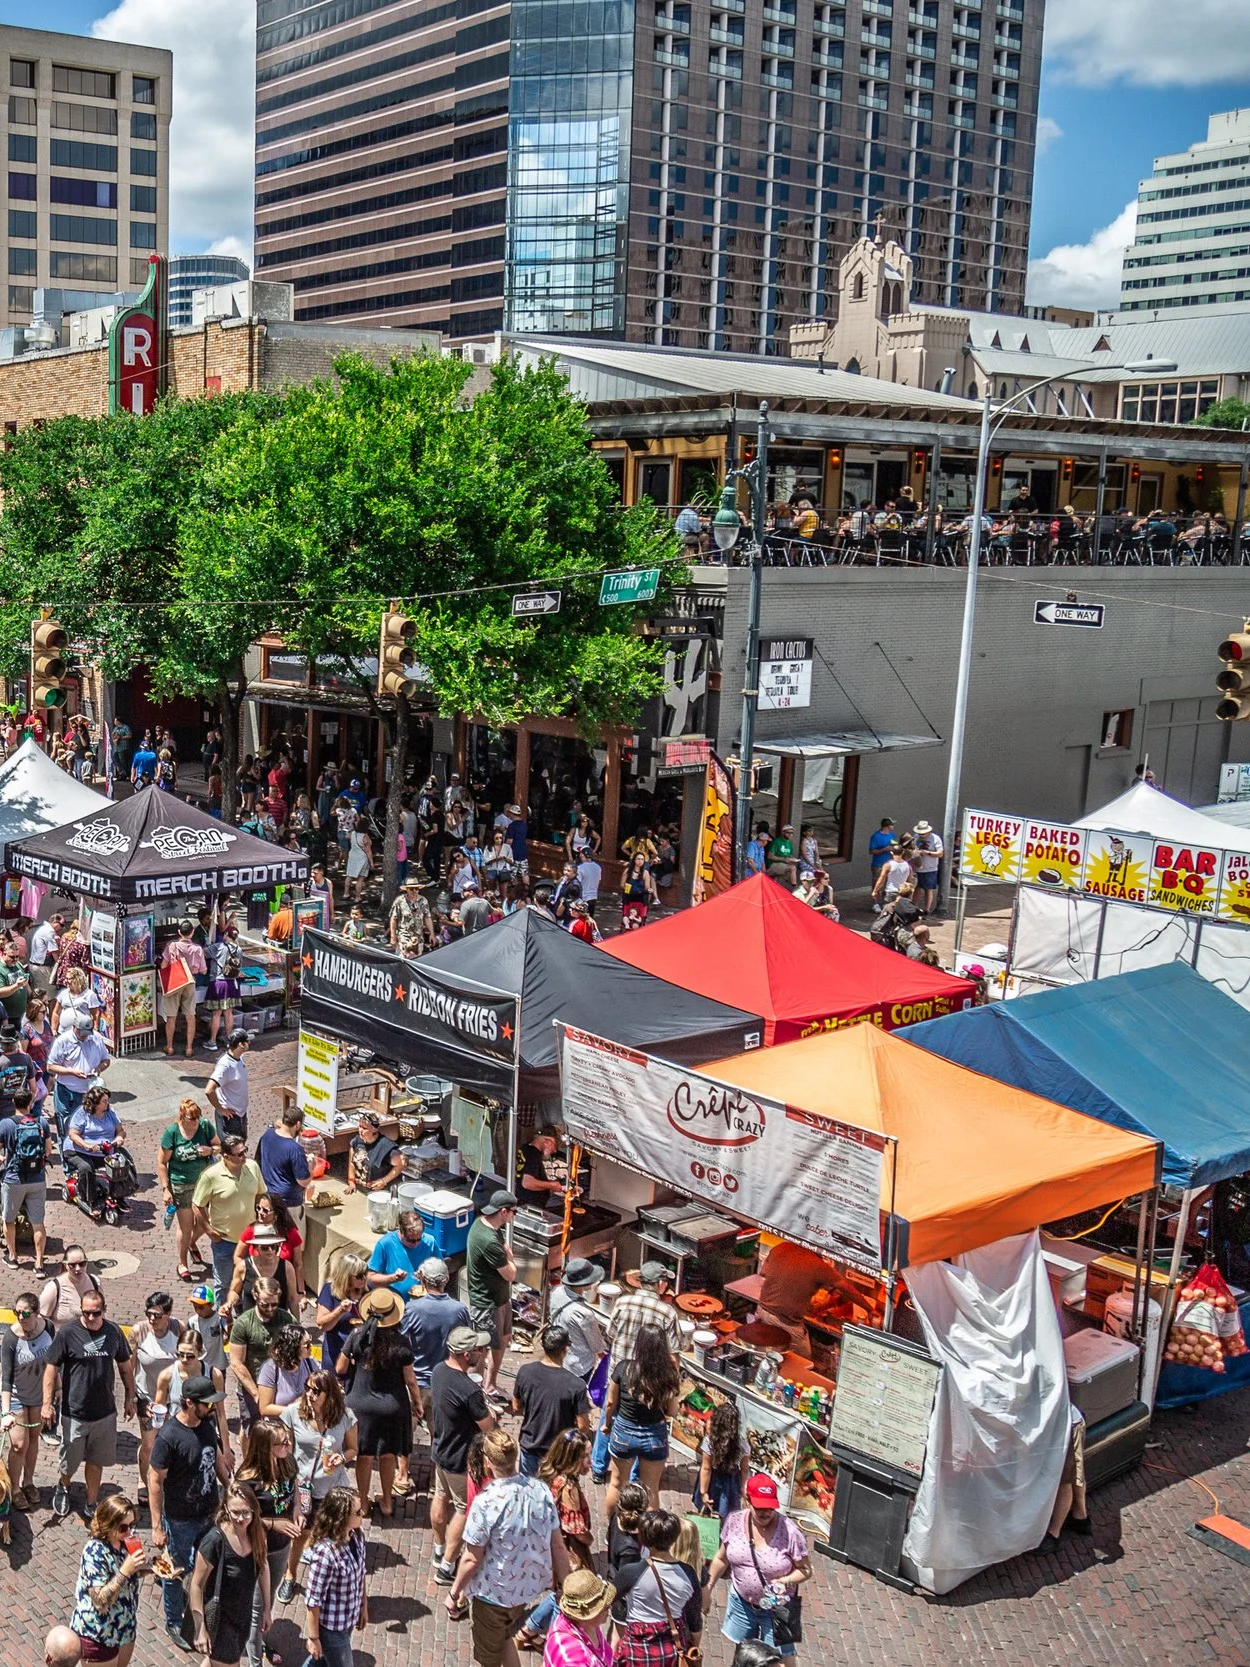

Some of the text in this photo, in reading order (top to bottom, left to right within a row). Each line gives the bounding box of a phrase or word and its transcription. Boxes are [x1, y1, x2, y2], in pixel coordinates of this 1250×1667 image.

[609, 571, 654, 591] Trinity ST
[517, 599, 546, 610] ONE WAY
[606, 593, 619, 603] 500
[637, 590, 650, 599] 600
[1054, 609, 1096, 620] ONE WAY
[770, 641, 807, 660] IRON CACTUS
[969, 814, 1021, 837] TURKEY
[1029, 825, 1080, 847] BAKED
[153, 827, 223, 850] PECAN
[975, 831, 1010, 850] LEGS
[1025, 841, 1081, 867] POTATO
[1153, 844, 1218, 877] BAR
[11, 852, 111, 898] MERCH BOOTH
[135, 861, 298, 898] MERCH BOOTH
[1085, 879, 1145, 903] SAUSAGE
[1150, 888, 1215, 913] SANDWICHES
[314, 949, 498, 1042] HAMBURGERS RIBBON FRIES
[891, 1001, 933, 1025] CORN
[572, 1029, 632, 1060] SAVORY
[612, 1070, 636, 1084] AVOCADO
[674, 1081, 749, 1131] Crêpe
[733, 1116, 766, 1138] CRAZY
[804, 1112, 870, 1143] SWEET
[692, 1140, 722, 1152] SAVORY
[729, 1145, 751, 1153] SWEET
[838, 1137, 863, 1151] BANANA
[799, 1162, 870, 1194] DULCE DE LECHE TURTLE
[800, 1181, 820, 1194] SWEET
[820, 1189, 843, 1202] CHEESE
[797, 1212, 811, 1223] we
[858, 1263, 880, 1278] 78704
[848, 1341, 876, 1356] SAVORY
[903, 1361, 929, 1376] SWEET
